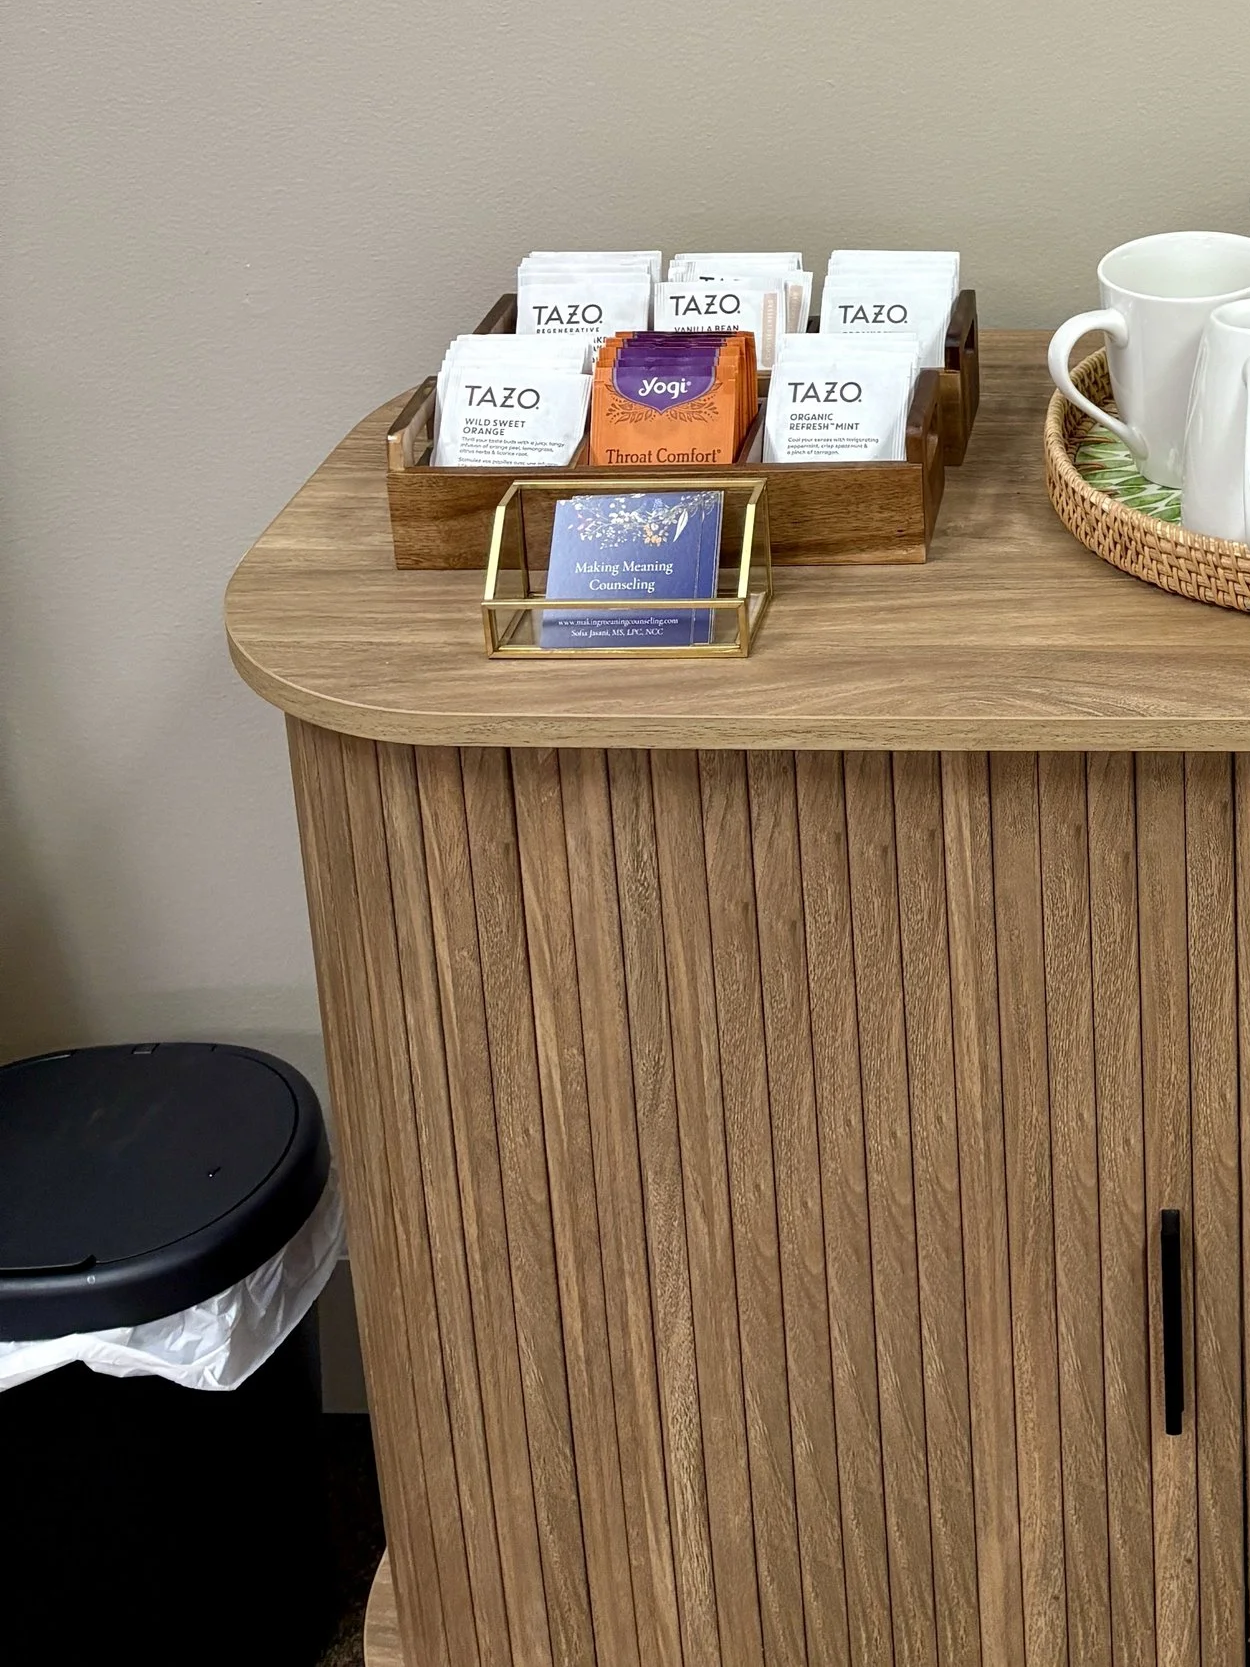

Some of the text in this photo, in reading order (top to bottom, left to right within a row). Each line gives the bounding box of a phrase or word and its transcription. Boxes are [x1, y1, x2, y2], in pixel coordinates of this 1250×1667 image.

[790, 413, 834, 421] ORGANIC
[465, 418, 526, 428] WILD SWEET
[835, 422, 860, 431] MINT
[463, 426, 505, 436] ORANGE
[605, 448, 652, 464] Throat
[574, 560, 674, 576] Making Meaning
[588, 577, 656, 594] Counseling
[558, 617, 679, 629] www.makingmeaningcounseling.com
